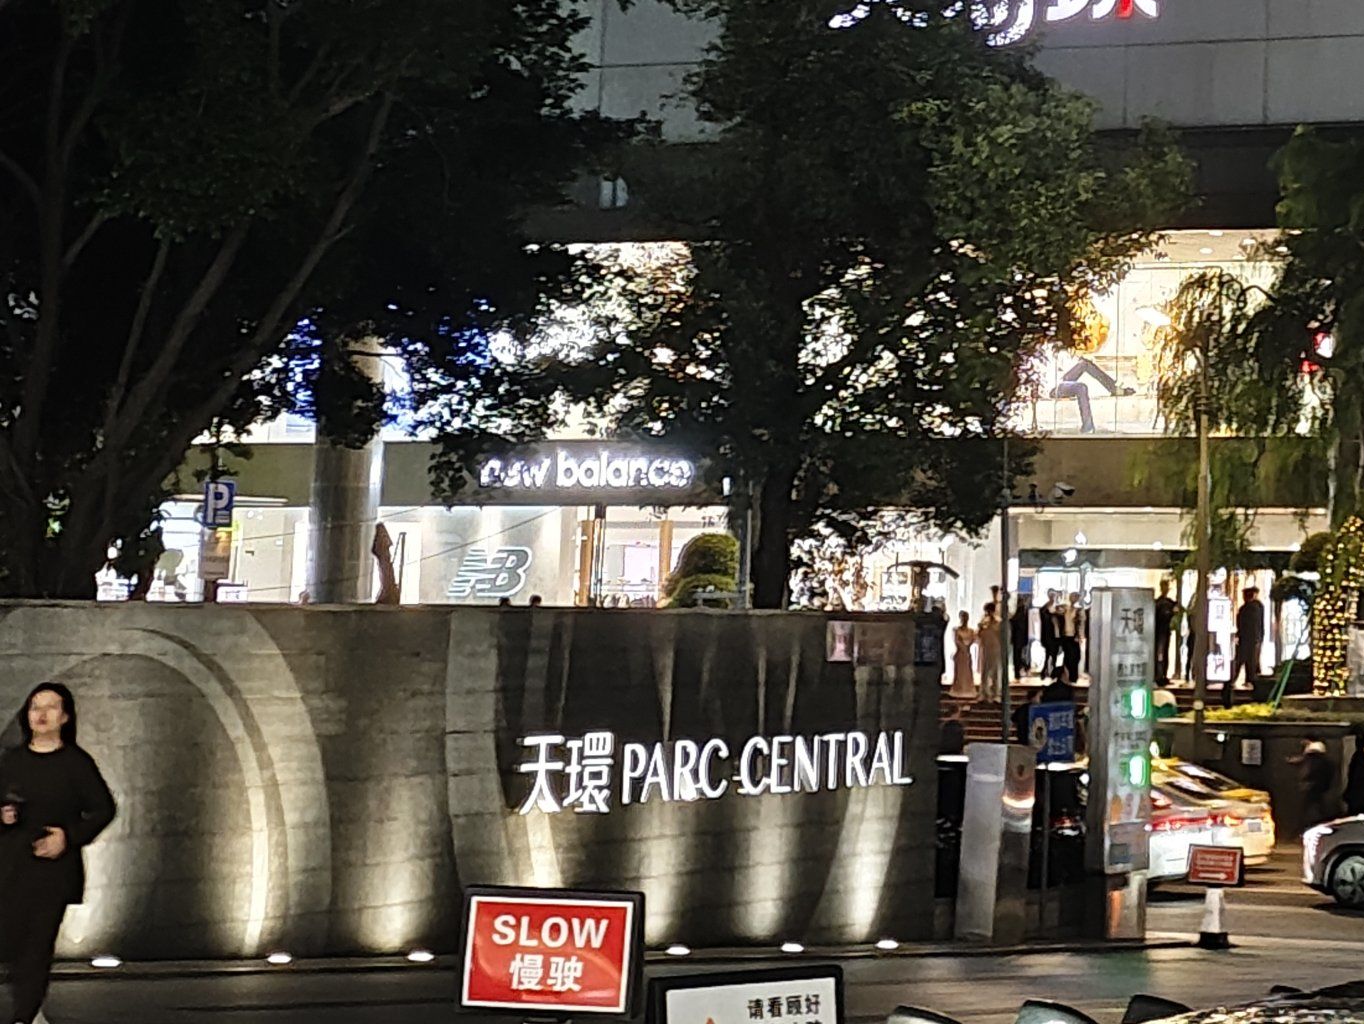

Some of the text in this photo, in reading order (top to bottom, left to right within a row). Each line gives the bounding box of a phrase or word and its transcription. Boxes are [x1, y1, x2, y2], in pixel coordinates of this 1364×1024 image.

[556, 449, 692, 488] balance
[207, 482, 230, 524] P
[517, 731, 913, 816] 天環 PARC CENTRAL
[492, 914, 609, 949] SLOW
[509, 952, 584, 993] 慢驶
[747, 994, 821, 1020] 请看顾好
